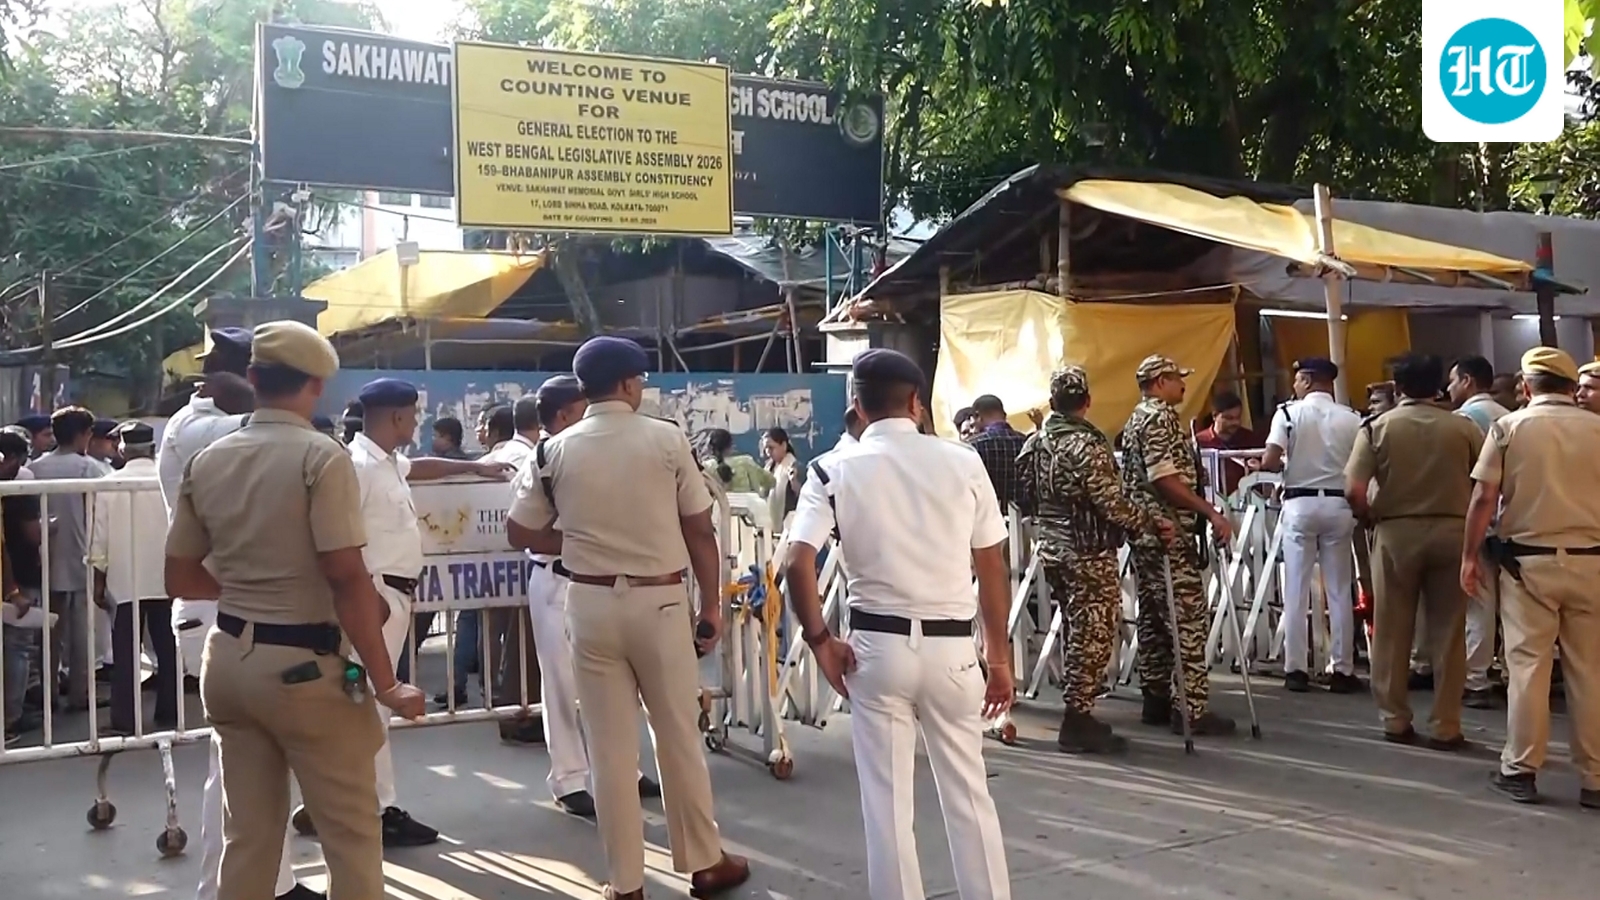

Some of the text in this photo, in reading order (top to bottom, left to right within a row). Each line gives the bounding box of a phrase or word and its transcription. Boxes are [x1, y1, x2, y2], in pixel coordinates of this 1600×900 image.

[322, 40, 450, 86] SAKHAWAT
[527, 60, 666, 84] WELCOME TO
[500, 79, 691, 106] COUNTING VENUE
[578, 104, 620, 119] FOR
[757, 88, 832, 125] SCHOOL
[517, 121, 678, 145] GENERAL ELECTION TO THE
[467, 141, 501, 157] WEST
[505, 143, 554, 161] BENGAL
[558, 146, 632, 165] LEGISLATIVE
[635, 151, 694, 168] ASSEMBLY
[697, 155, 723, 170] 2026
[478, 164, 713, 187] 159-BHABANIPUR ASSEMBLY CONSTITUENCY
[525, 185, 565, 195] SAKHAWAT
[567, 187, 605, 196] MEMORIAL
[652, 191, 669, 199] HIGH
[671, 191, 698, 201] SCHOOL
[543, 200, 562, 209] LORD
